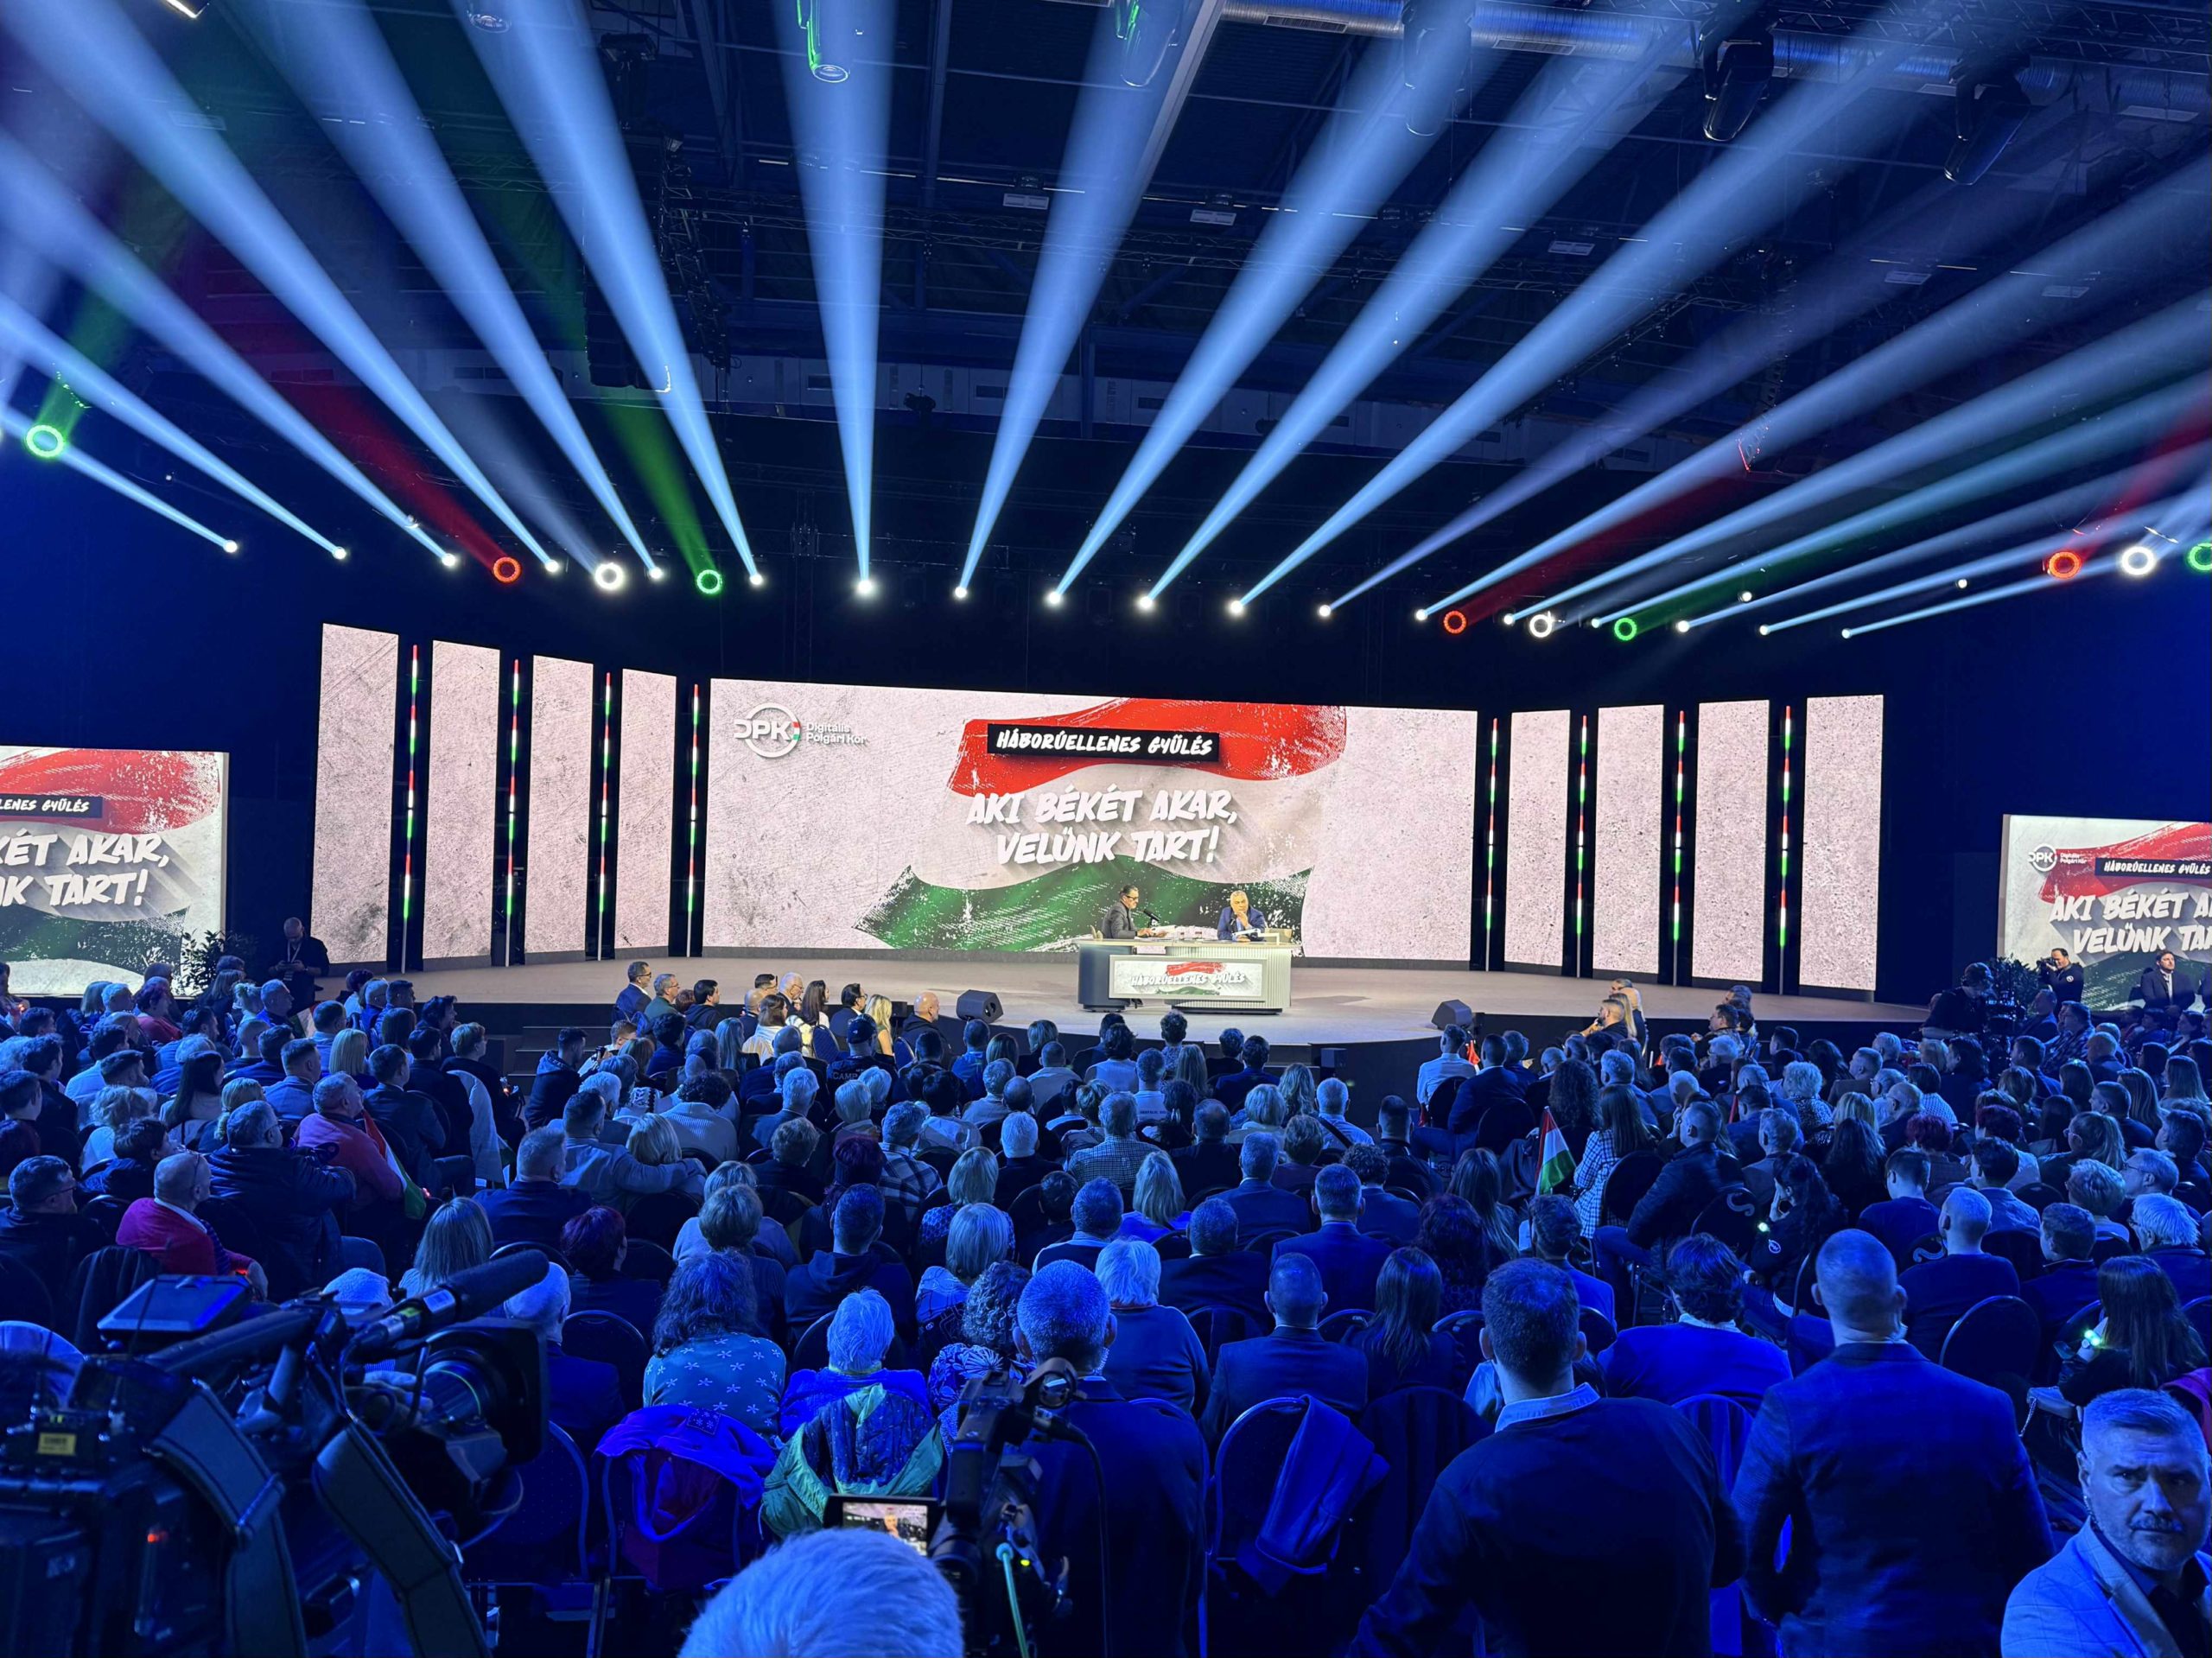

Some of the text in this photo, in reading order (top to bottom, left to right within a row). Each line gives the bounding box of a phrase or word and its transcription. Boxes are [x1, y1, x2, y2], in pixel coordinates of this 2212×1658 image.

[734, 718, 791, 740] DPK
[996, 728, 1213, 756] HÁBORÚELLENES GYŰLÉS
[41, 797, 90, 813] GYŰLÉS
[966, 783, 1238, 824] AKI BÉKÉT AKAR,
[66, 833, 169, 867] AKAR,
[996, 825, 1220, 864] VELÜNK TART!
[2104, 861, 2176, 873] HÁBORÚELLENES
[44, 868, 149, 906] TART!
[2049, 895, 2096, 922] AKI
[2102, 886, 2190, 920] BÉKÉT
[2074, 922, 2172, 954] VELÜNK
